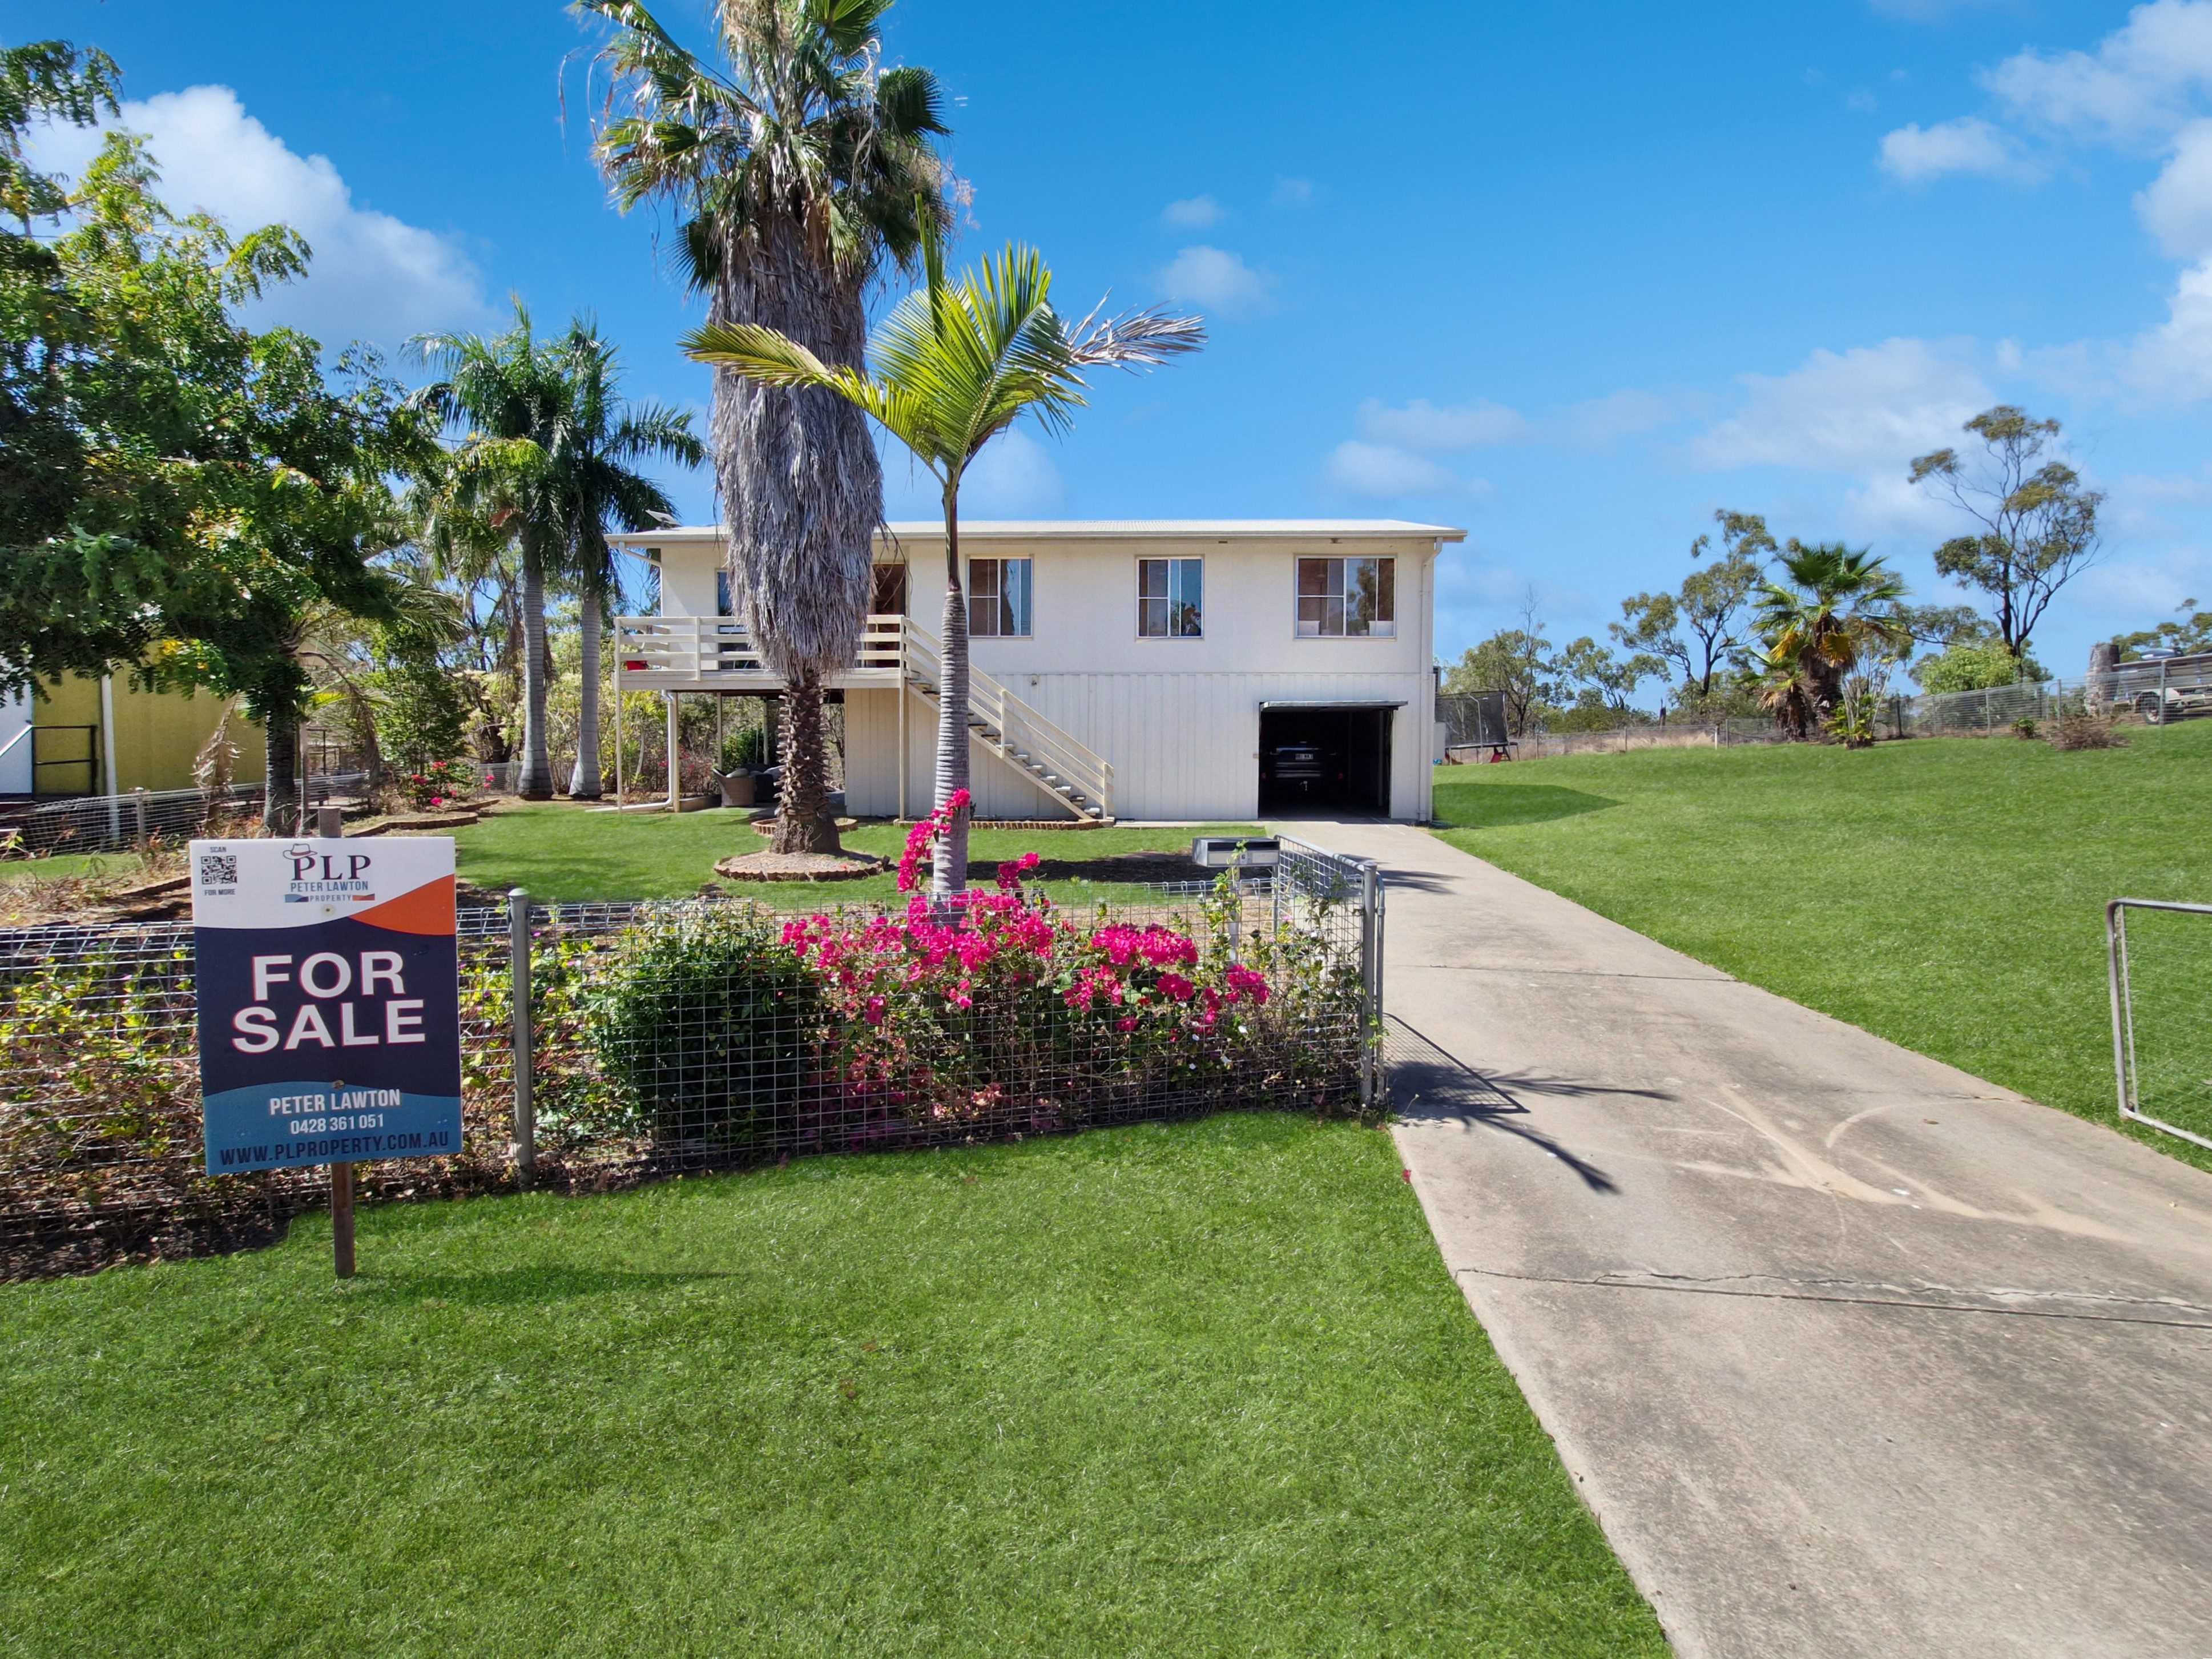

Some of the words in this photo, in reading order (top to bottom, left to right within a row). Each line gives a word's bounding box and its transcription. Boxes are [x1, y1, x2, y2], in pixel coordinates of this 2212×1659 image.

[291, 855, 371, 880] PLP
[291, 882, 323, 892] PETER
[327, 881, 369, 892] LAWTON
[252, 951, 406, 1001] FOR
[231, 999, 426, 1053] SALE
[269, 1094, 325, 1116] PETER
[331, 1089, 401, 1111] LAWTON
[290, 1118, 327, 1134] 0428
[329, 1116, 355, 1131] 361
[358, 1113, 384, 1129] 051
[220, 1131, 449, 1165] WWW.PLPROPERTY.COM.AU
